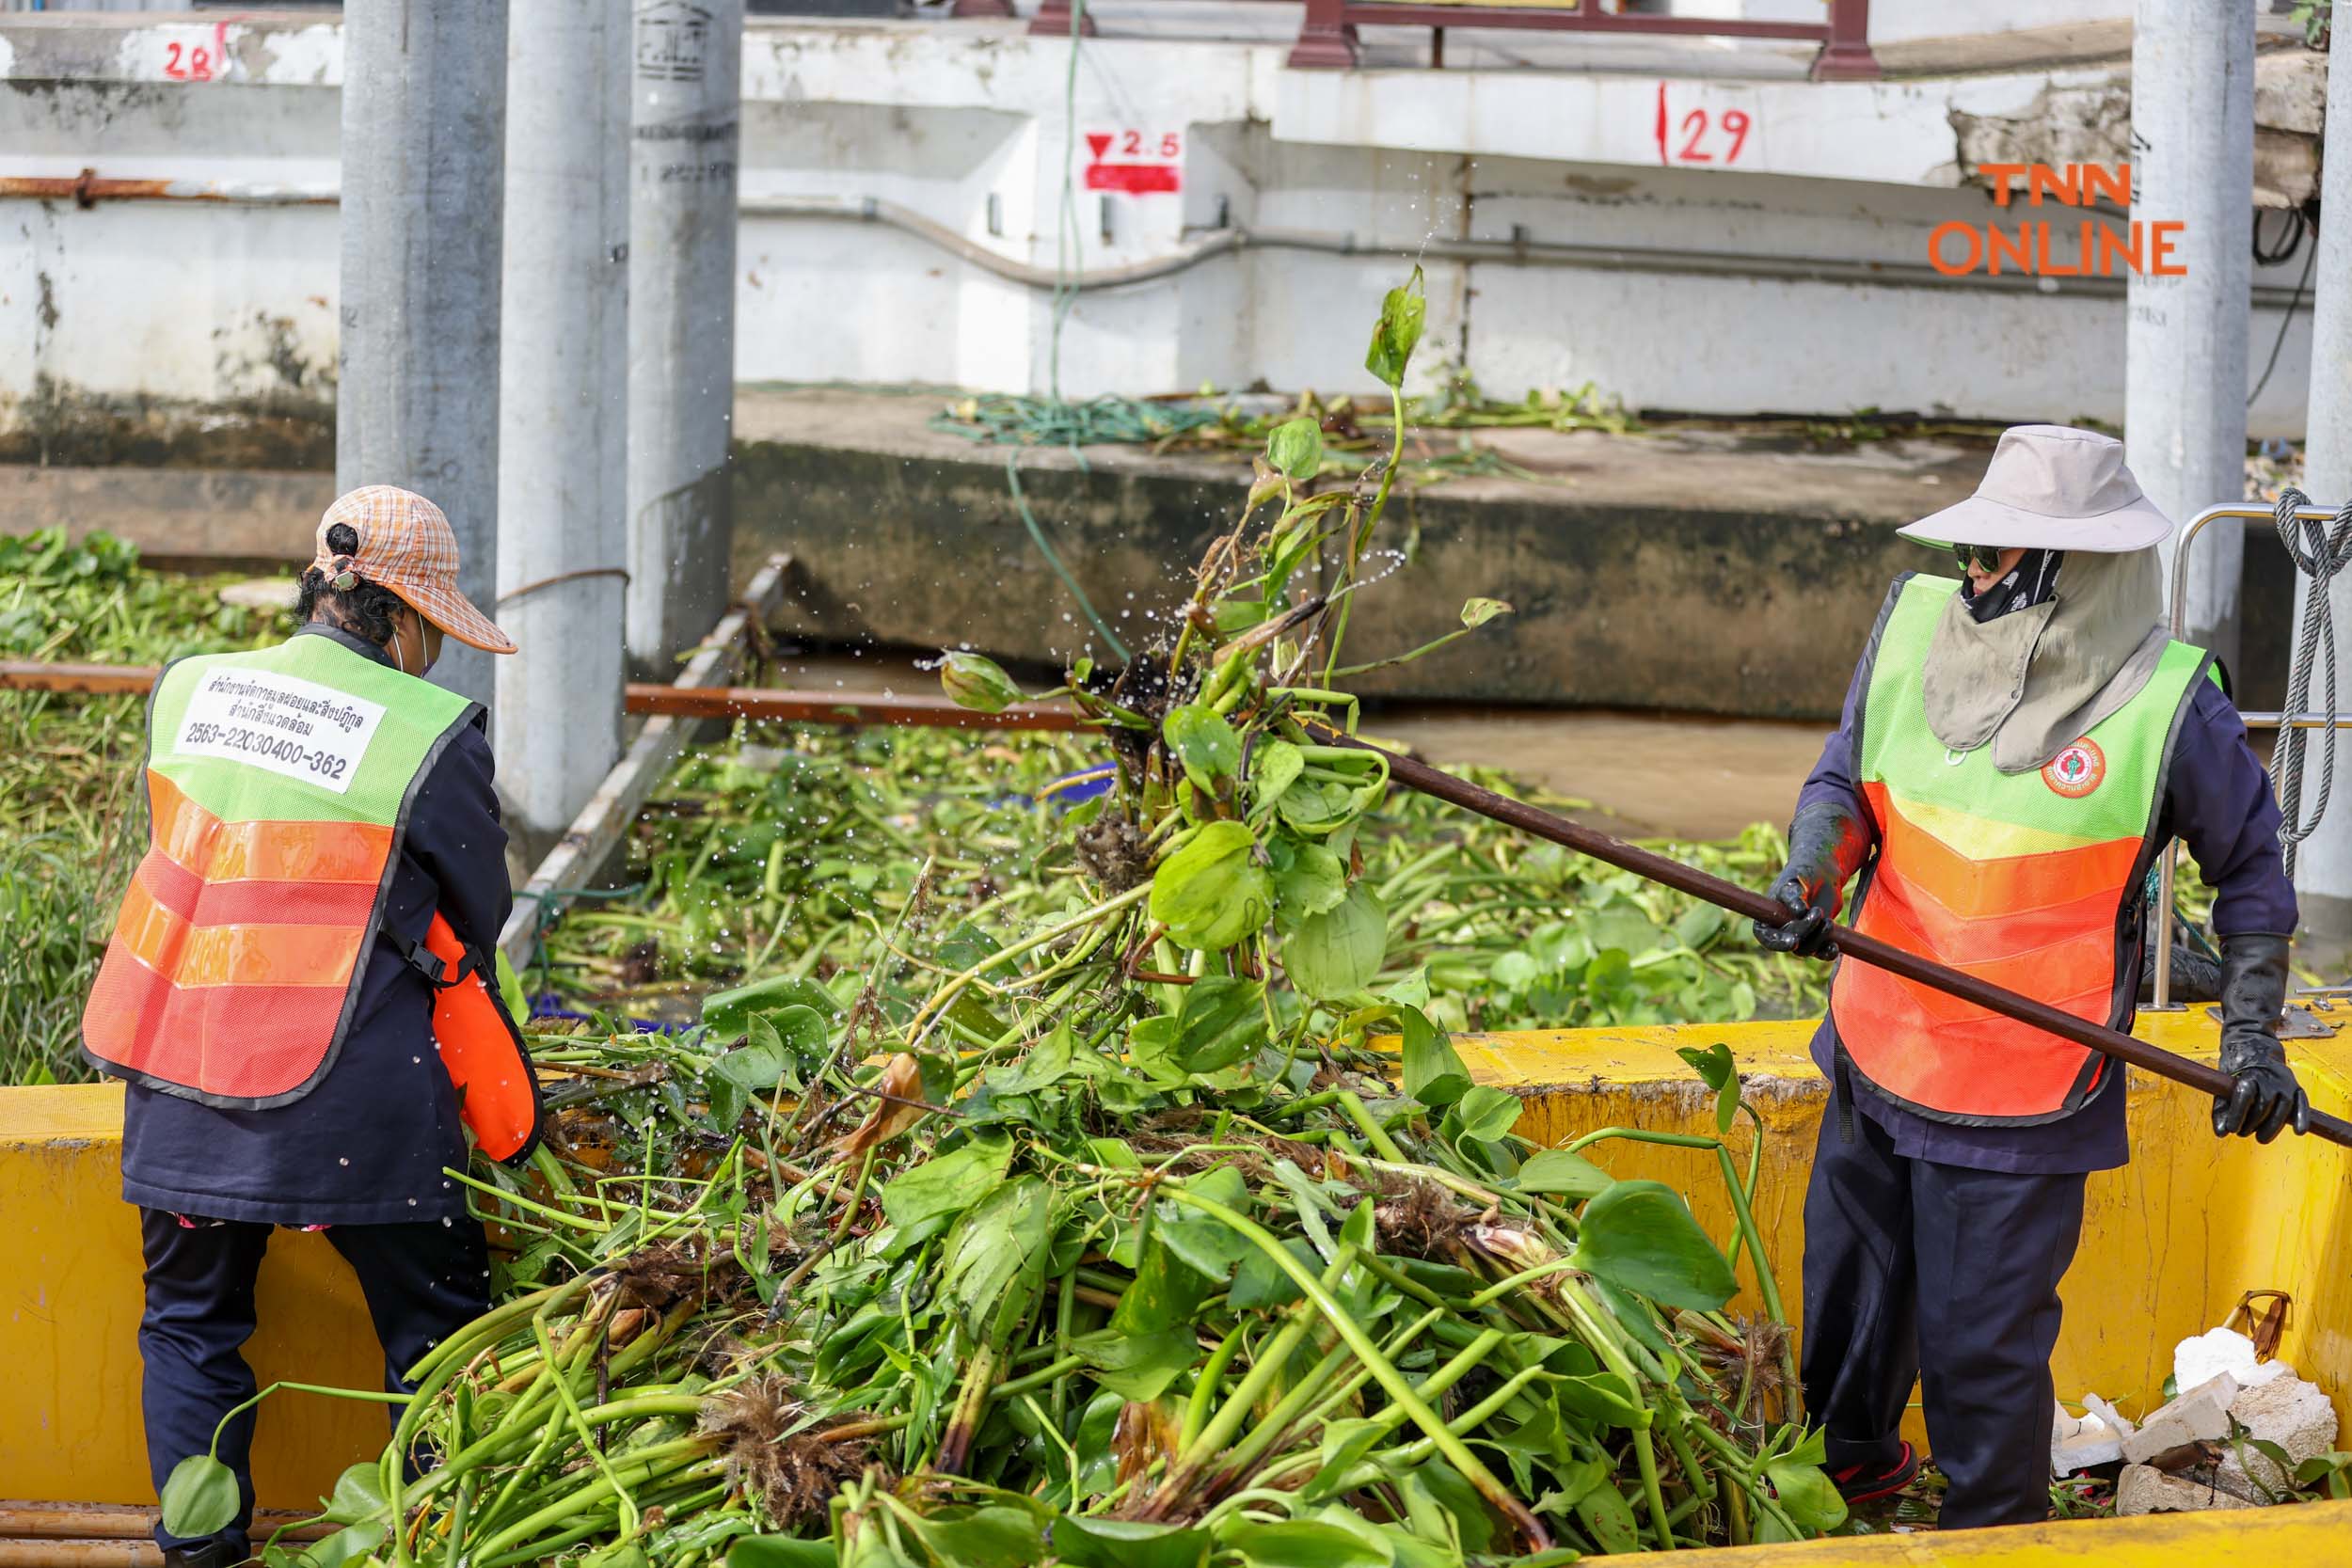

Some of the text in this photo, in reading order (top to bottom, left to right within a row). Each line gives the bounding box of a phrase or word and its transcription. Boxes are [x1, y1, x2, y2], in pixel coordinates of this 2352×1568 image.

[1122, 130, 1180, 158] 2.5
[229, 700, 314, 736] สำนักสิ่งแวดล้อม
[185, 721, 347, 780] 2563-22030400-362
